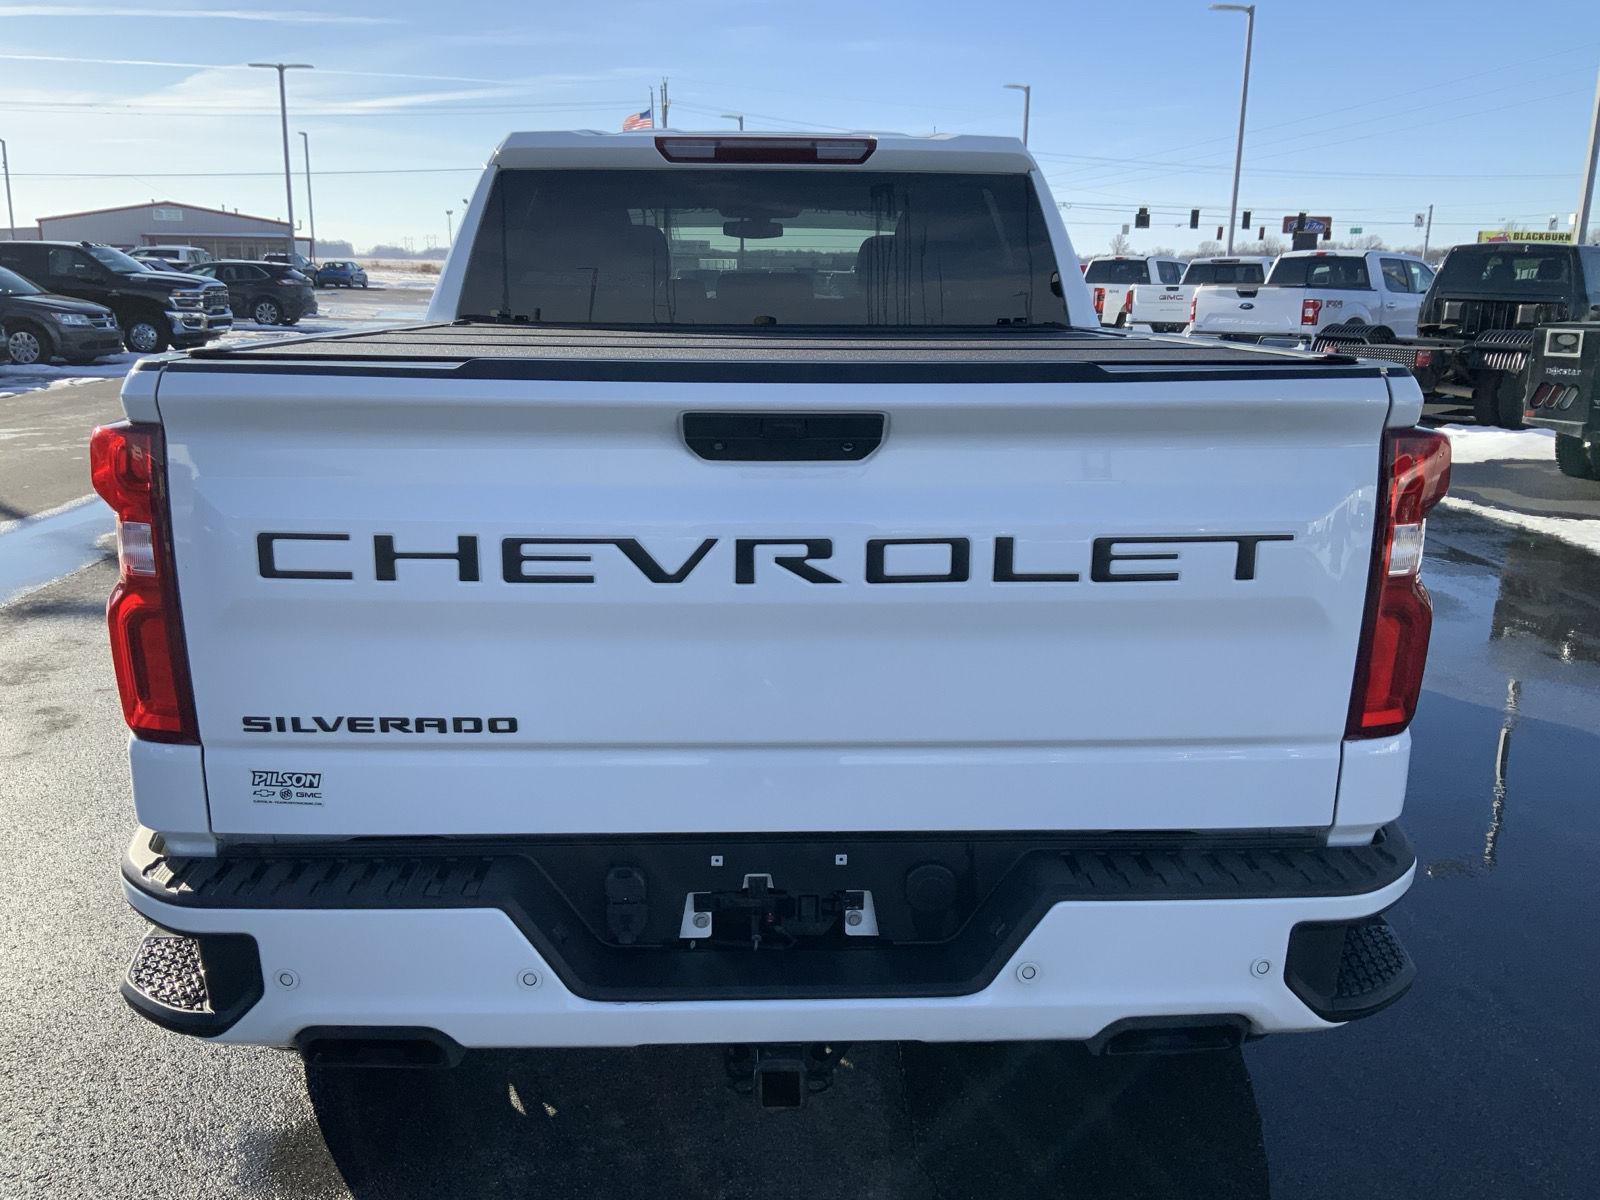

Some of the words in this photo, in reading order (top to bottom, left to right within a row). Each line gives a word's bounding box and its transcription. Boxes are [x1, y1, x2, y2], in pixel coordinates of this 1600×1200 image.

[1513, 232, 1572, 241] BLACKBURN
[257, 532, 1294, 584] CHEVROLET
[242, 716, 518, 734] SILVERADO
[251, 770, 322, 788] PILSON
